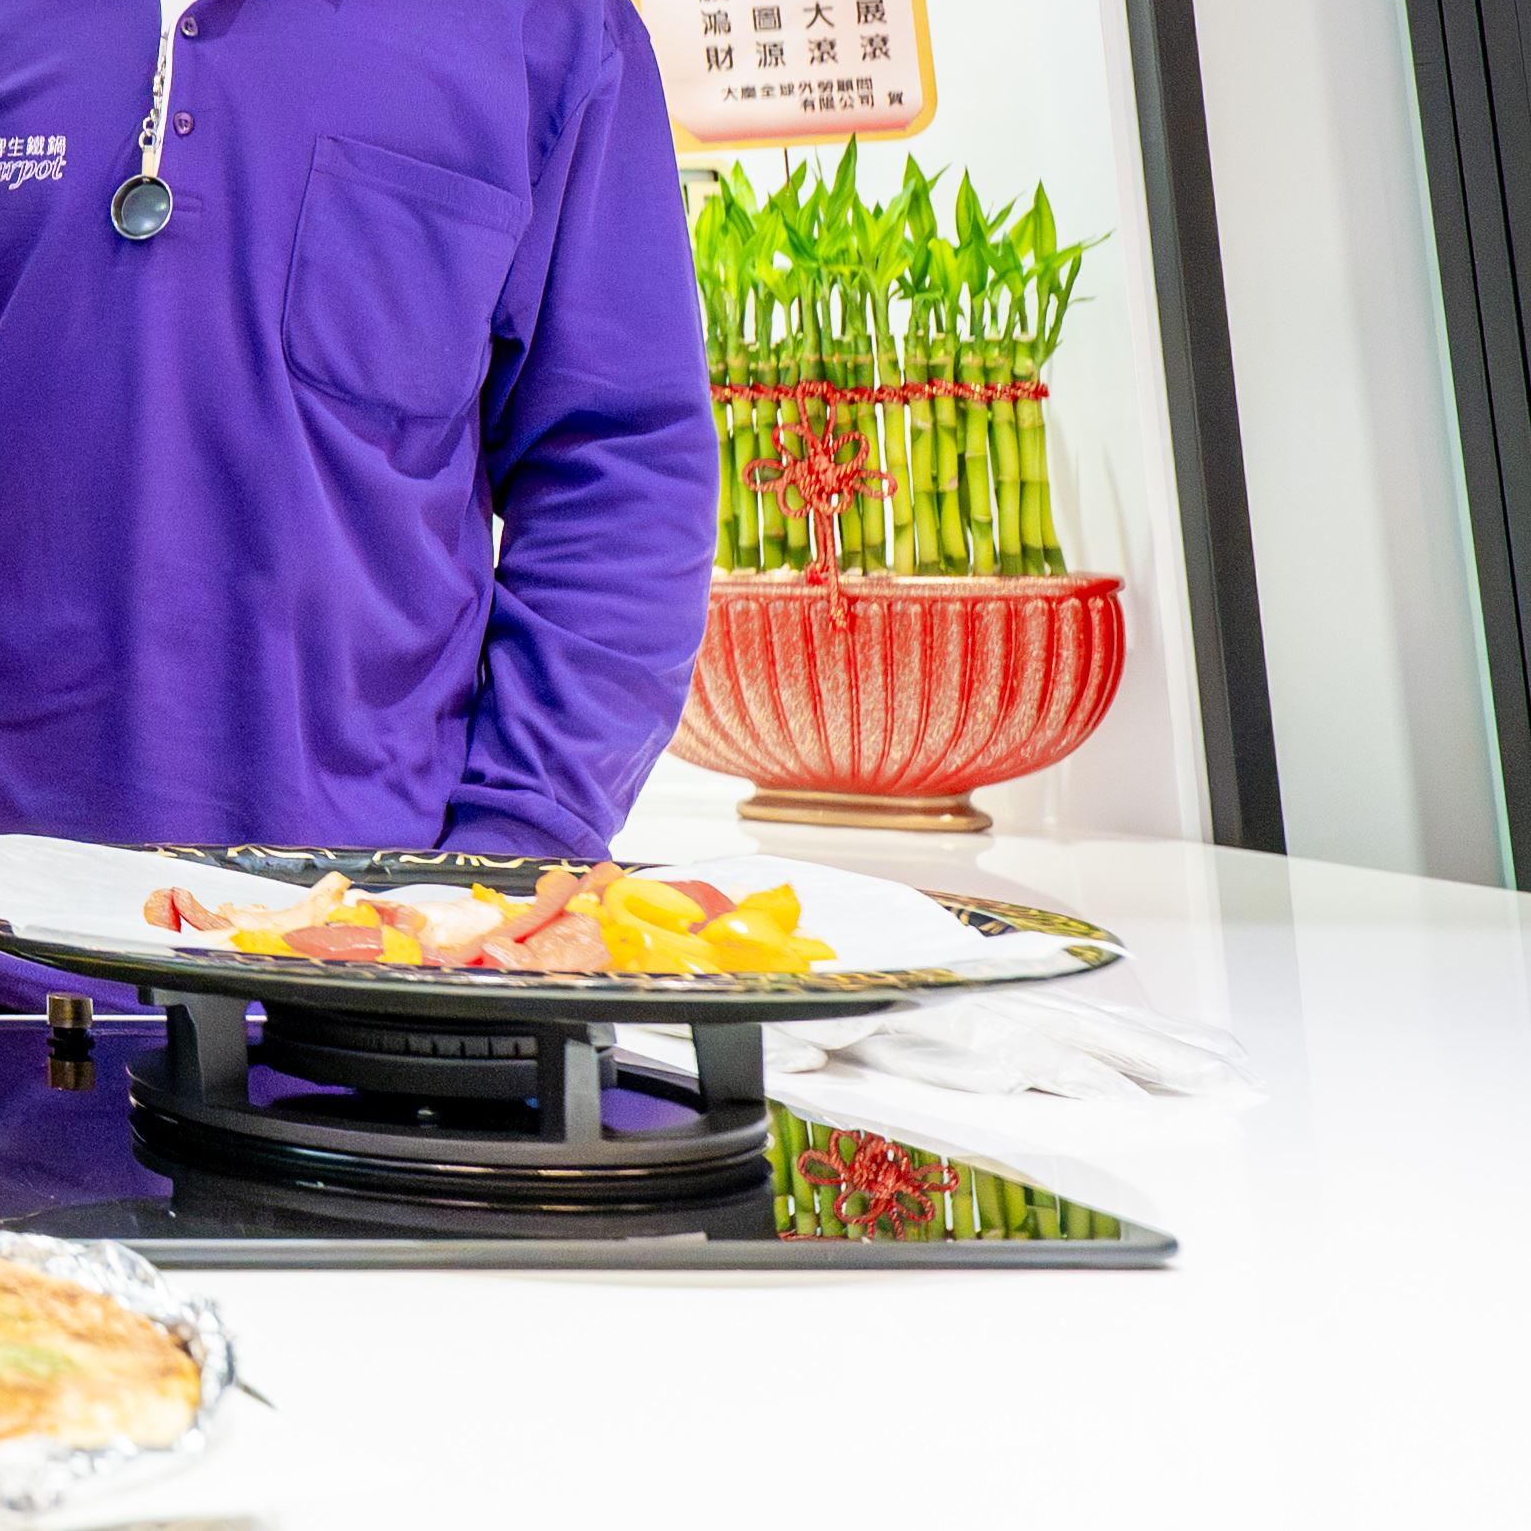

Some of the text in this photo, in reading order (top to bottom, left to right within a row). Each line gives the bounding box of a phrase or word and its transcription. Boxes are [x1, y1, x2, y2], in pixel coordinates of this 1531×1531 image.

[705, 33, 891, 72] 財源滾滾
[801, 94, 875, 113] 有限公司
